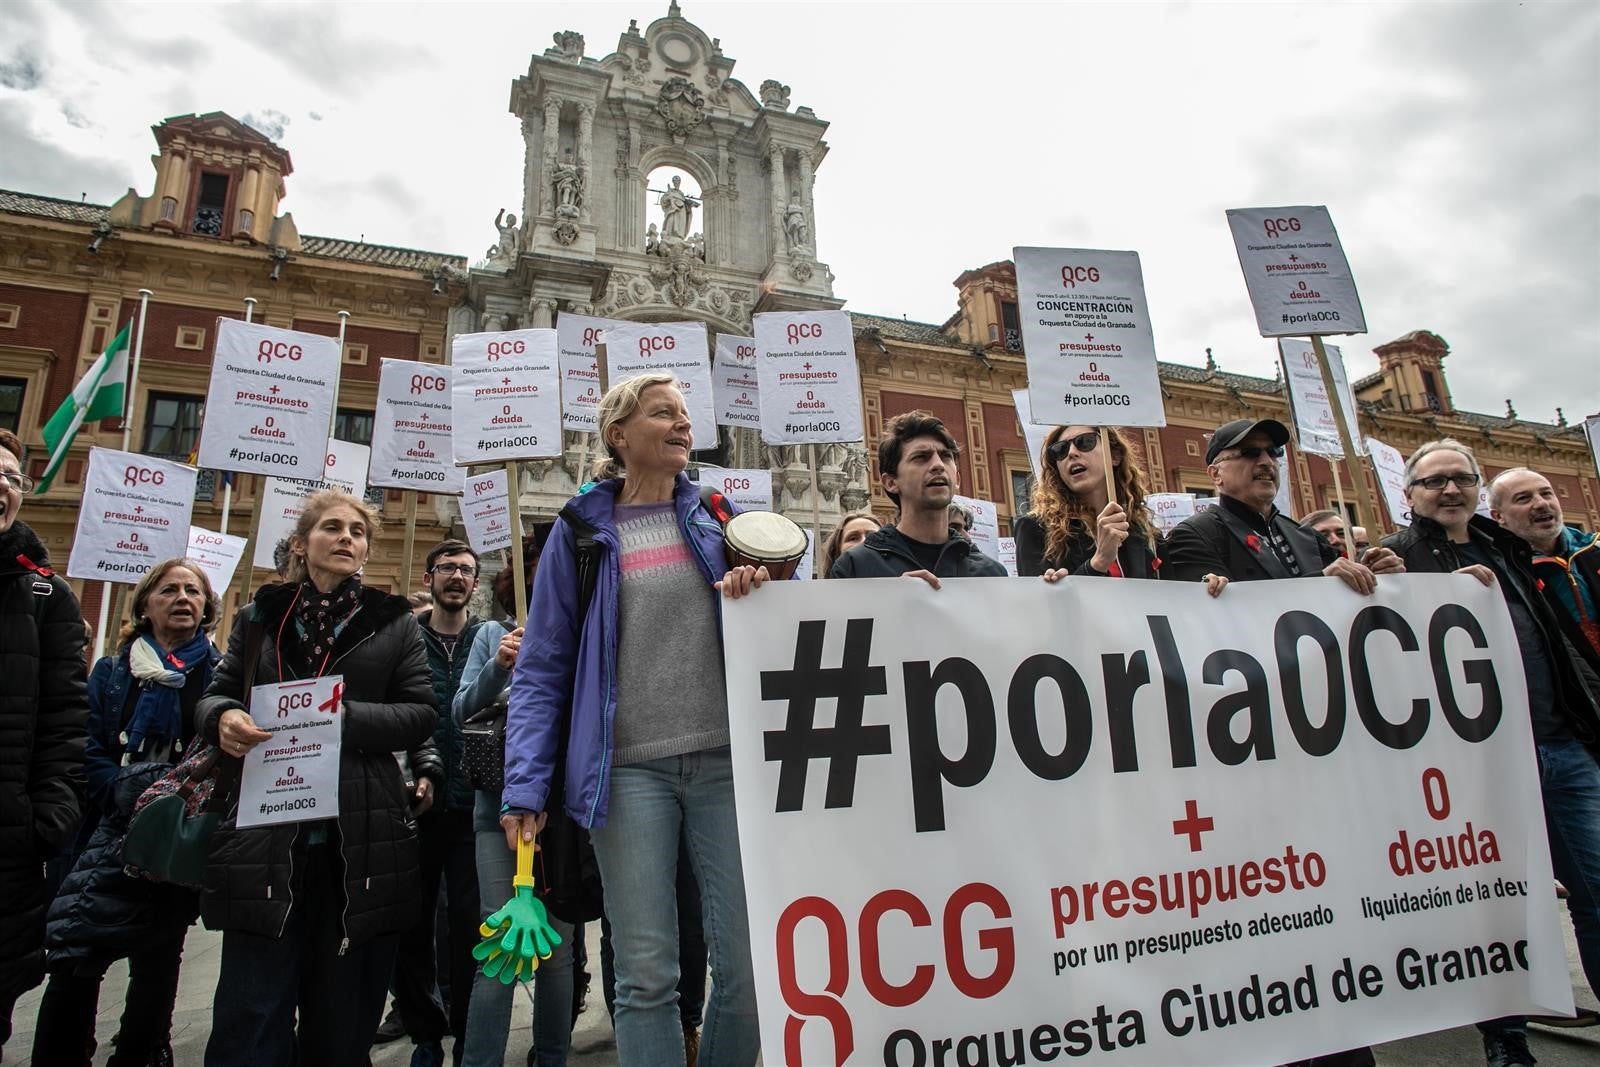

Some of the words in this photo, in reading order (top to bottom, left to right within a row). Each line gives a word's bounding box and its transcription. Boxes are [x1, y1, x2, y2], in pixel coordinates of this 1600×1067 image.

[1037, 301, 1133, 313] CONCENTRACIÓN
[1039, 319, 1071, 327] Orquesta
[1060, 343, 1121, 352] presupuesto
[226, 364, 259, 375] Orquesta
[261, 370, 285, 379] Ciudad
[297, 376, 325, 386] Granada
[780, 371, 837, 380] presupuesto
[1079, 372, 1110, 381] deuda
[475, 385, 537, 396] presupuesto
[237, 392, 308, 407] presupuesto
[797, 400, 825, 408] deuda
[1065, 394, 1130, 406] #porlaOCG
[491, 414, 522, 424] deuda
[250, 425, 285, 438] deuda
[395, 420, 451, 431] presupuesto
[785, 422, 839, 434] #porlaOCG
[478, 436, 537, 450] #porlaOCG
[230, 448, 297, 465] #porlaOCG
[407, 448, 434, 458] deuda
[392, 469, 444, 481] #porlaOCG
[309, 719, 332, 727] Granada
[760, 603, 1503, 832] #porlaOCG
[264, 743, 321, 758] presupuesto
[275, 776, 303, 786] deuda
[1422, 767, 1451, 821] 0
[260, 798, 315, 814] #porlaOCG
[1172, 799, 1215, 852] +
[1388, 821, 1502, 877] deuda
[1050, 845, 1327, 940] presupuesto
[1360, 886, 1453, 921] liquidación
[1456, 883, 1474, 905] de
[1476, 880, 1491, 901] la
[1494, 877, 1528, 898] deu
[1053, 947, 1087, 976] por
[1094, 942, 1119, 964] un
[1125, 919, 1243, 963] presupuesto
[1248, 904, 1334, 936] adecuado
[883, 1005, 1147, 1067] Orquesta
[1160, 964, 1320, 1037] Ciudad
[1331, 957, 1385, 1004] de
